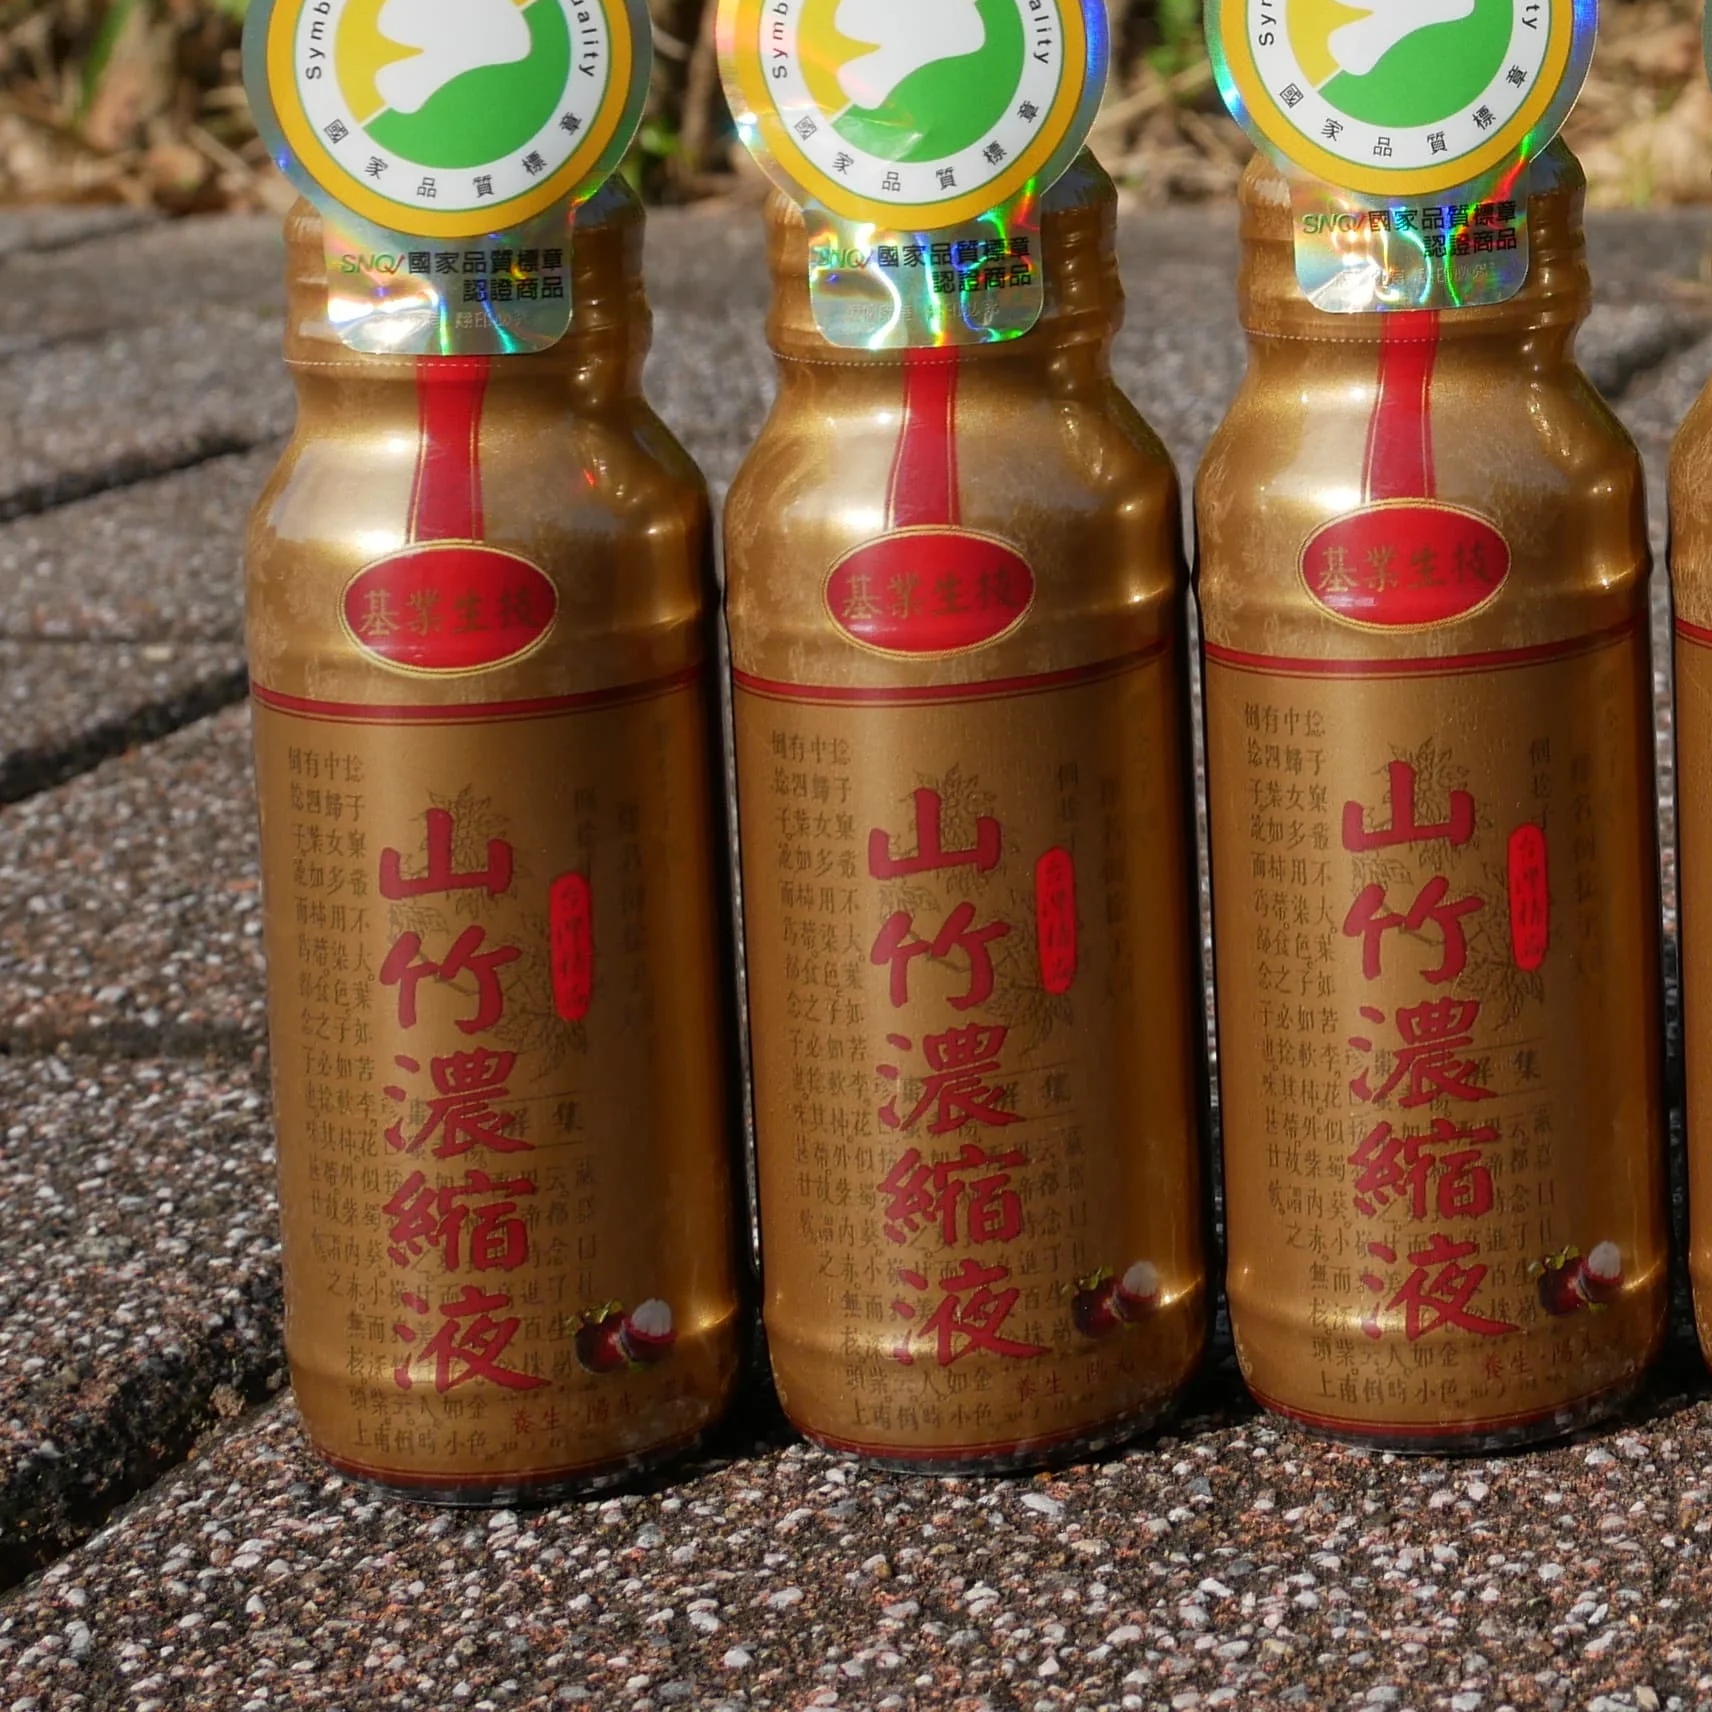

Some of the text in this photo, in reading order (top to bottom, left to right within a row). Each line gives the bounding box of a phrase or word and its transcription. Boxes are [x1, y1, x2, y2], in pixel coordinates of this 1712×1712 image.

[408, 249, 563, 275] 國家品質標章
[463, 276, 564, 302] 認證商品
[379, 807, 553, 1393] 山竹濃縮液
[868, 788, 1054, 1367] 山竹濃縮液
[1342, 760, 1520, 1342] 山竹濃縮液
